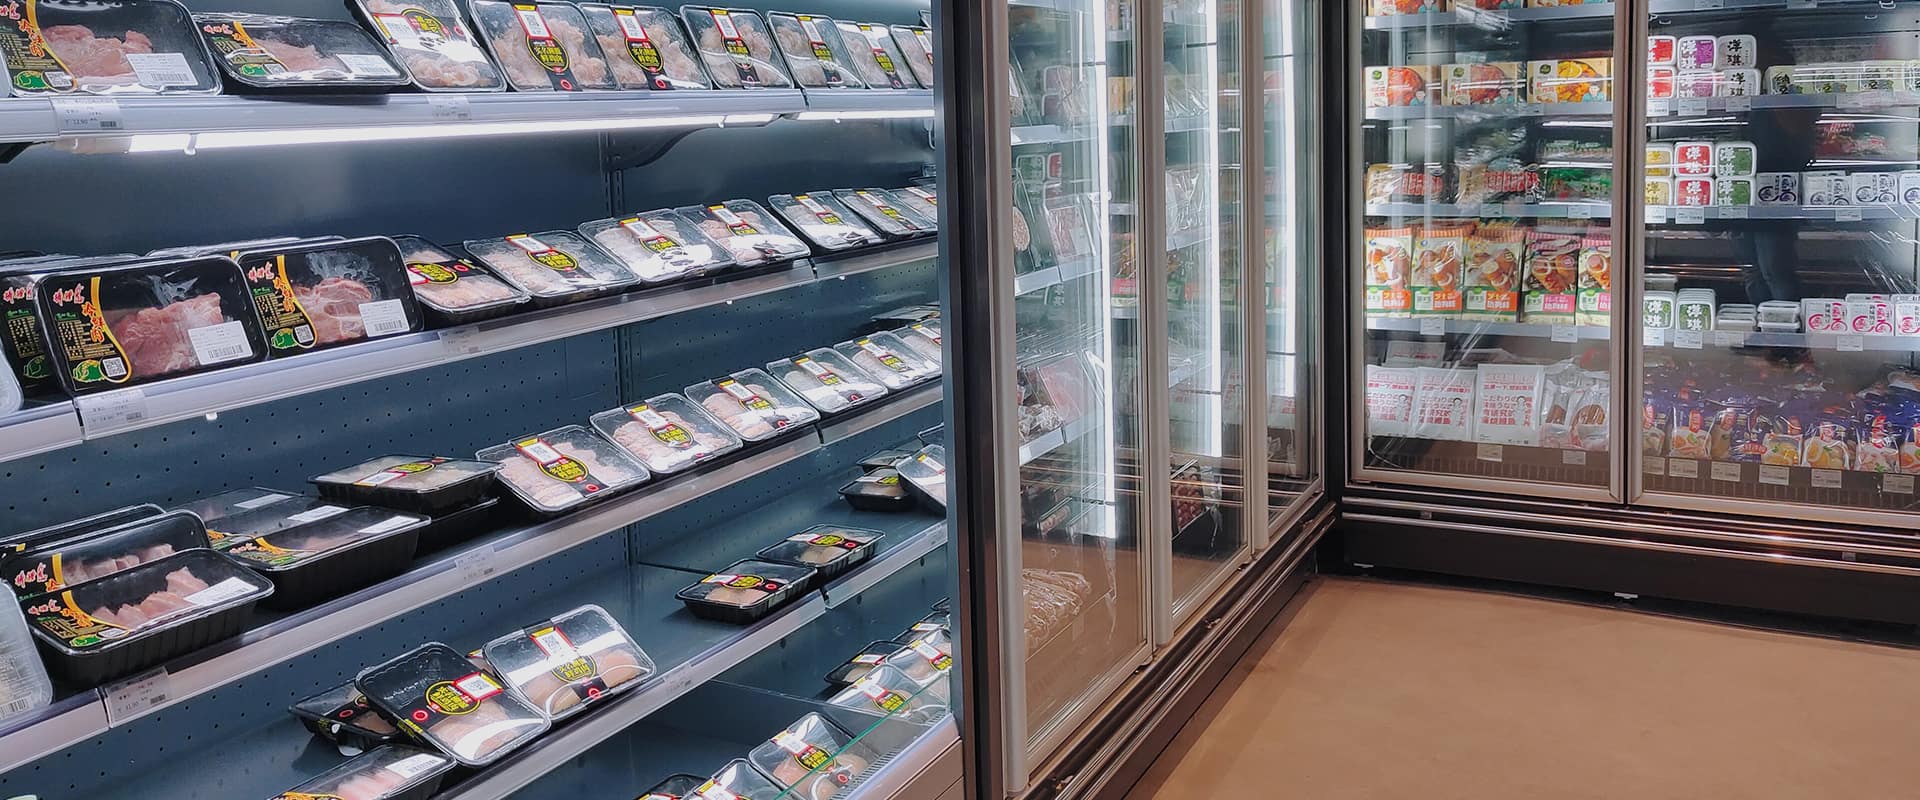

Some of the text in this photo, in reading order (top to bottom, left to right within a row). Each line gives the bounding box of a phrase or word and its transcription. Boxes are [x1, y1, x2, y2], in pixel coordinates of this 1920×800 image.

[1727, 38, 1745, 66] 洋琪
[81, 301, 105, 343] 冷鲜肉
[1685, 303, 1703, 331] 洋琪
